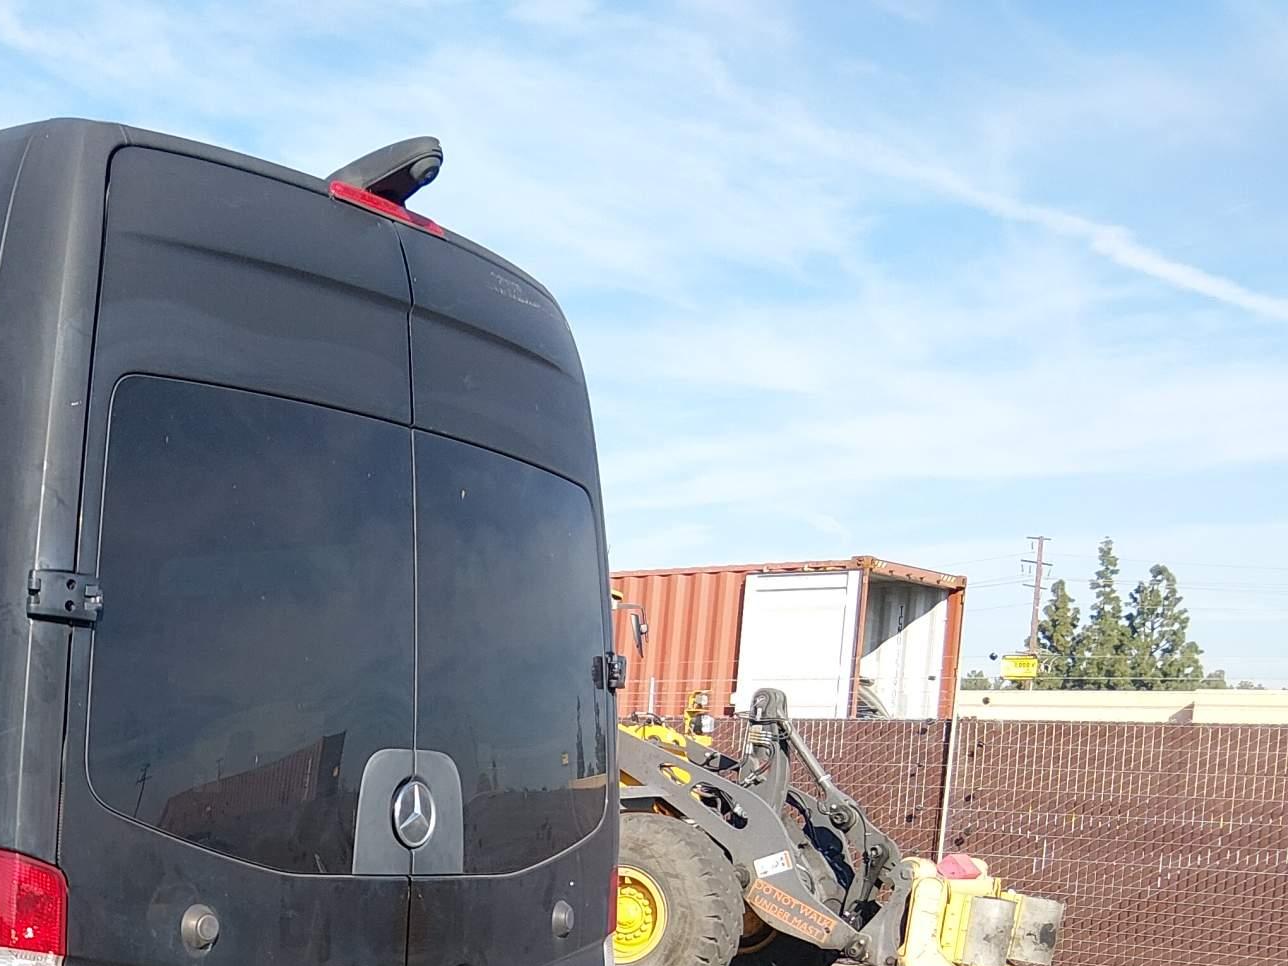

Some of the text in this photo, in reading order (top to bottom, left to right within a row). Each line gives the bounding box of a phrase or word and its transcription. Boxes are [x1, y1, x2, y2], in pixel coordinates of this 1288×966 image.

[754, 881, 832, 927] DO NOT WALK
[754, 895, 821, 937] UNDER MAST
